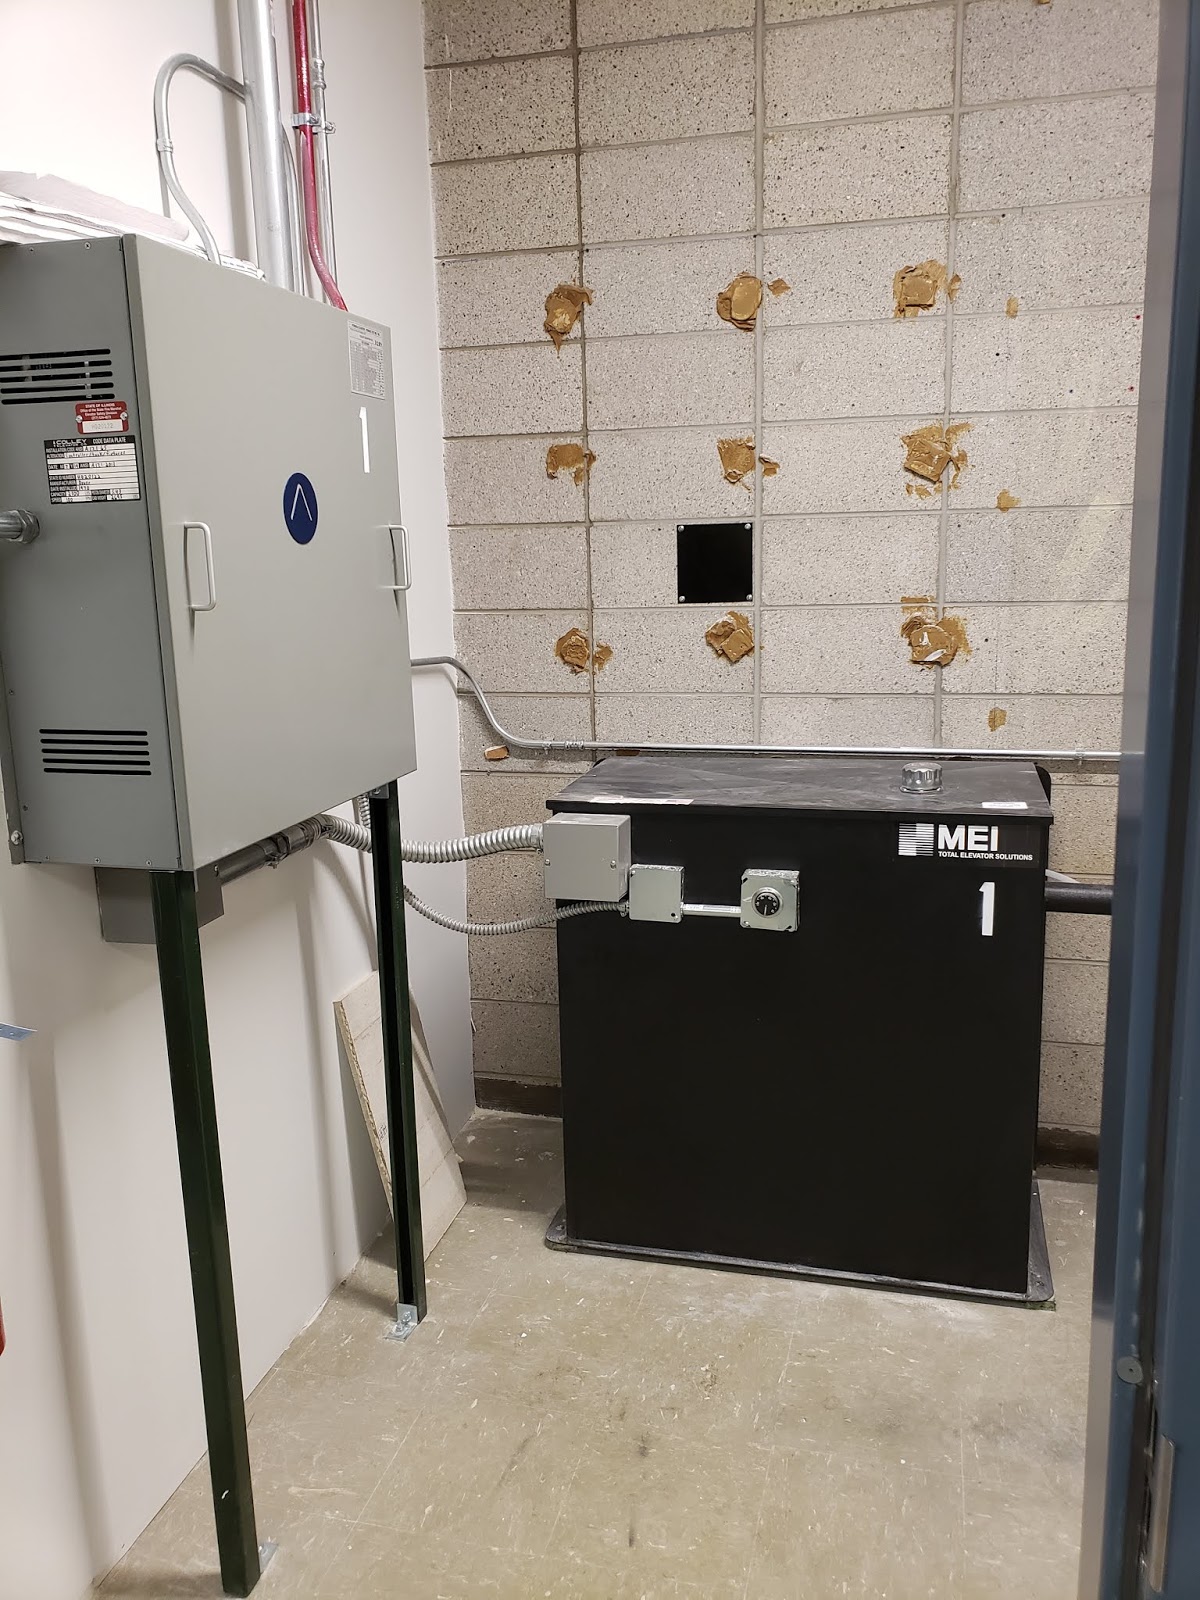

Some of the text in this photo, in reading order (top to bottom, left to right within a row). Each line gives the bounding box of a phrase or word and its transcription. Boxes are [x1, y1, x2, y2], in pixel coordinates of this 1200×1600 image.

[359, 406, 370, 473] 1
[938, 824, 999, 851] MEI
[960, 852, 994, 860] ELEVATOR
[995, 853, 1033, 861] SOLUTIONS
[979, 882, 995, 936] 1
